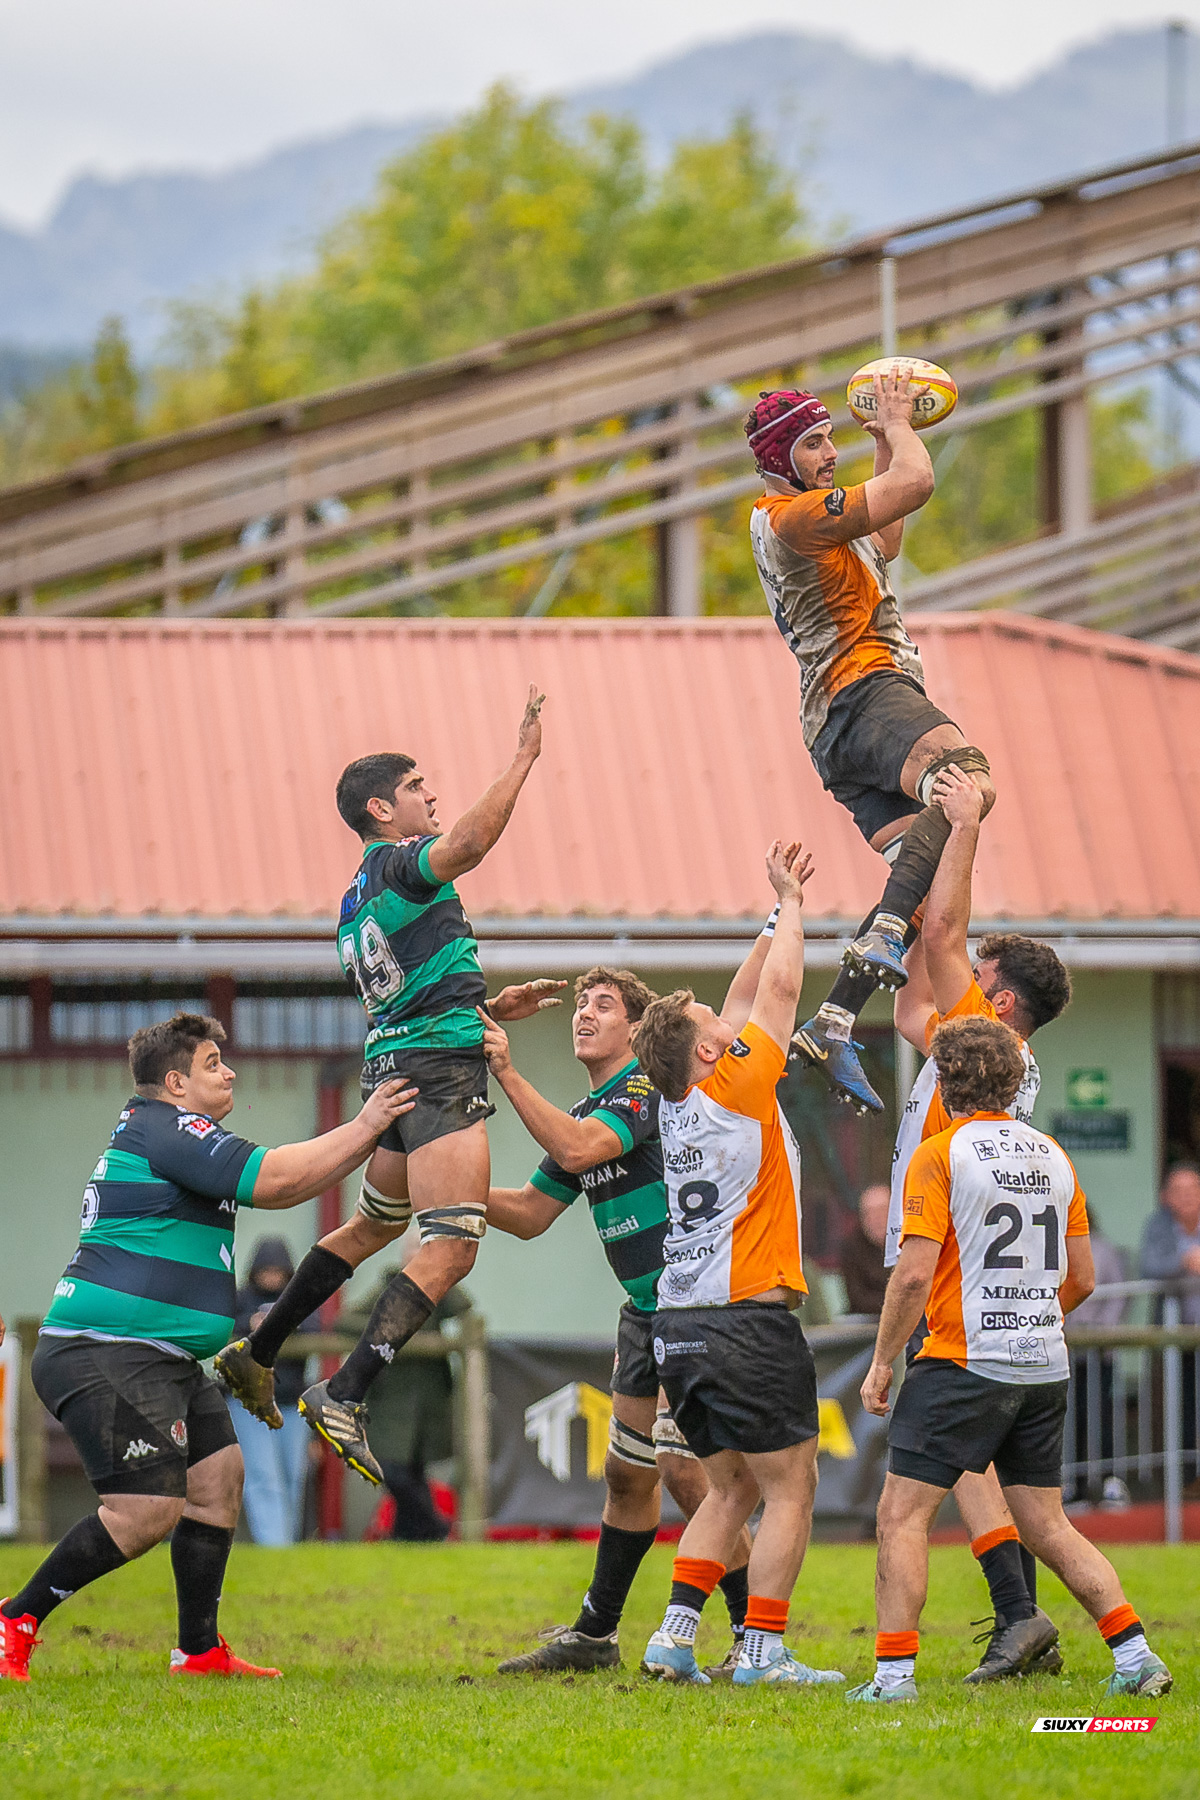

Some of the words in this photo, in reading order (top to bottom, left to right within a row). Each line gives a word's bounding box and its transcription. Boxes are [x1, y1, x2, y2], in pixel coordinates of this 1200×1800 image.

[1000, 1142, 1049, 1154] CAVO
[991, 1169, 1051, 1187] Vitaldin
[1023, 1187, 1051, 1195] SPORT
[983, 1202, 1059, 1270] 21
